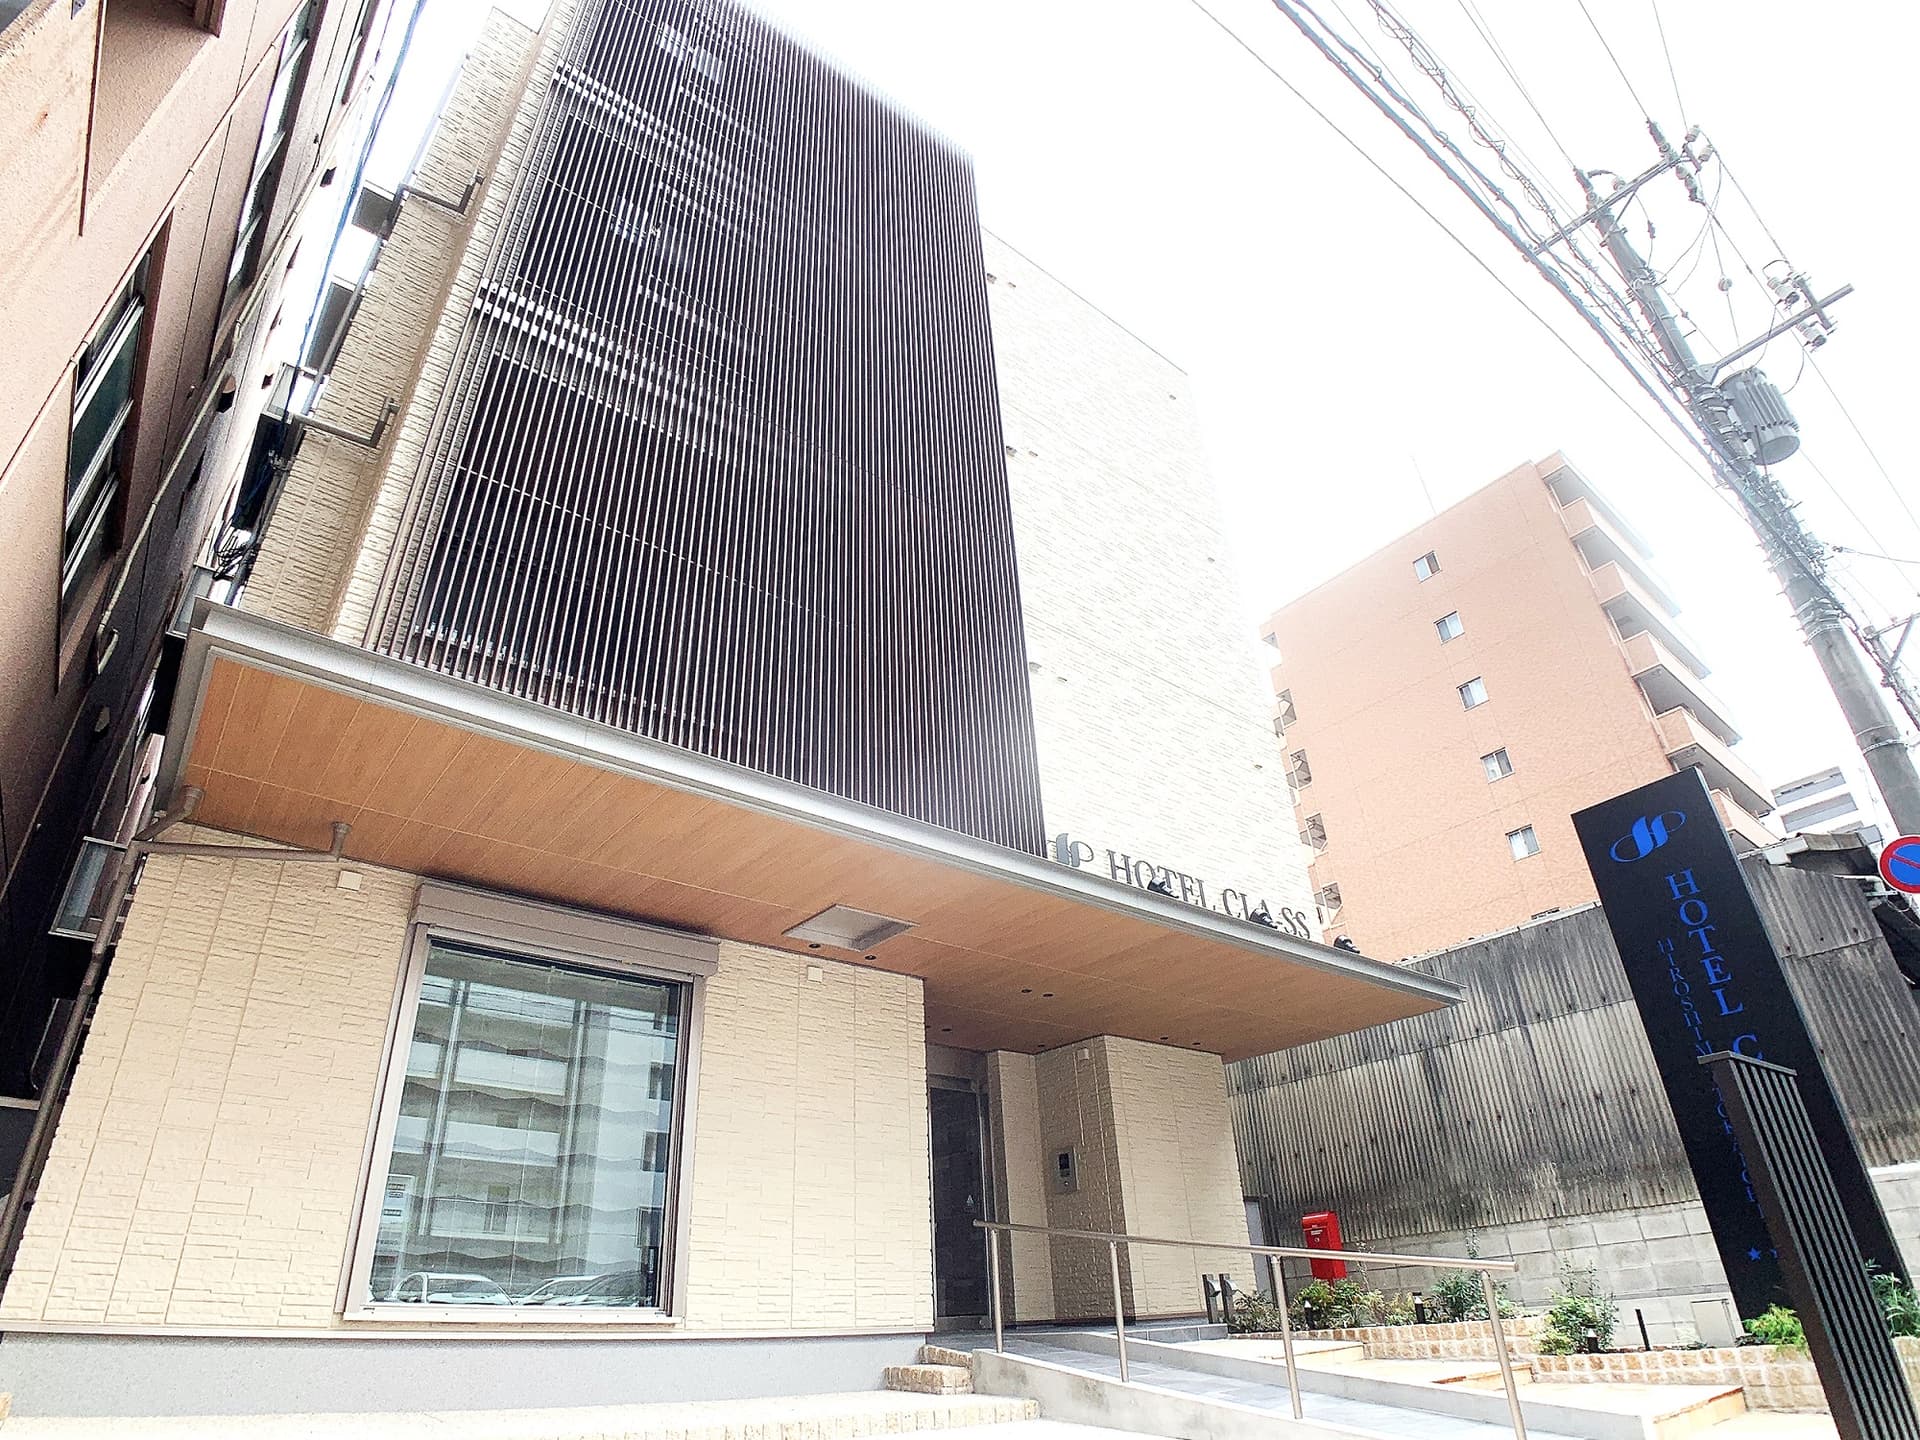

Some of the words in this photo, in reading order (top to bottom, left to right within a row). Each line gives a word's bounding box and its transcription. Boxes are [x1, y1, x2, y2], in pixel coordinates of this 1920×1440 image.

[1105, 848, 1216, 911] HOTEL
[1657, 937, 1713, 1057] HIROSHIM
[1665, 868, 1744, 1016] HOTEL
